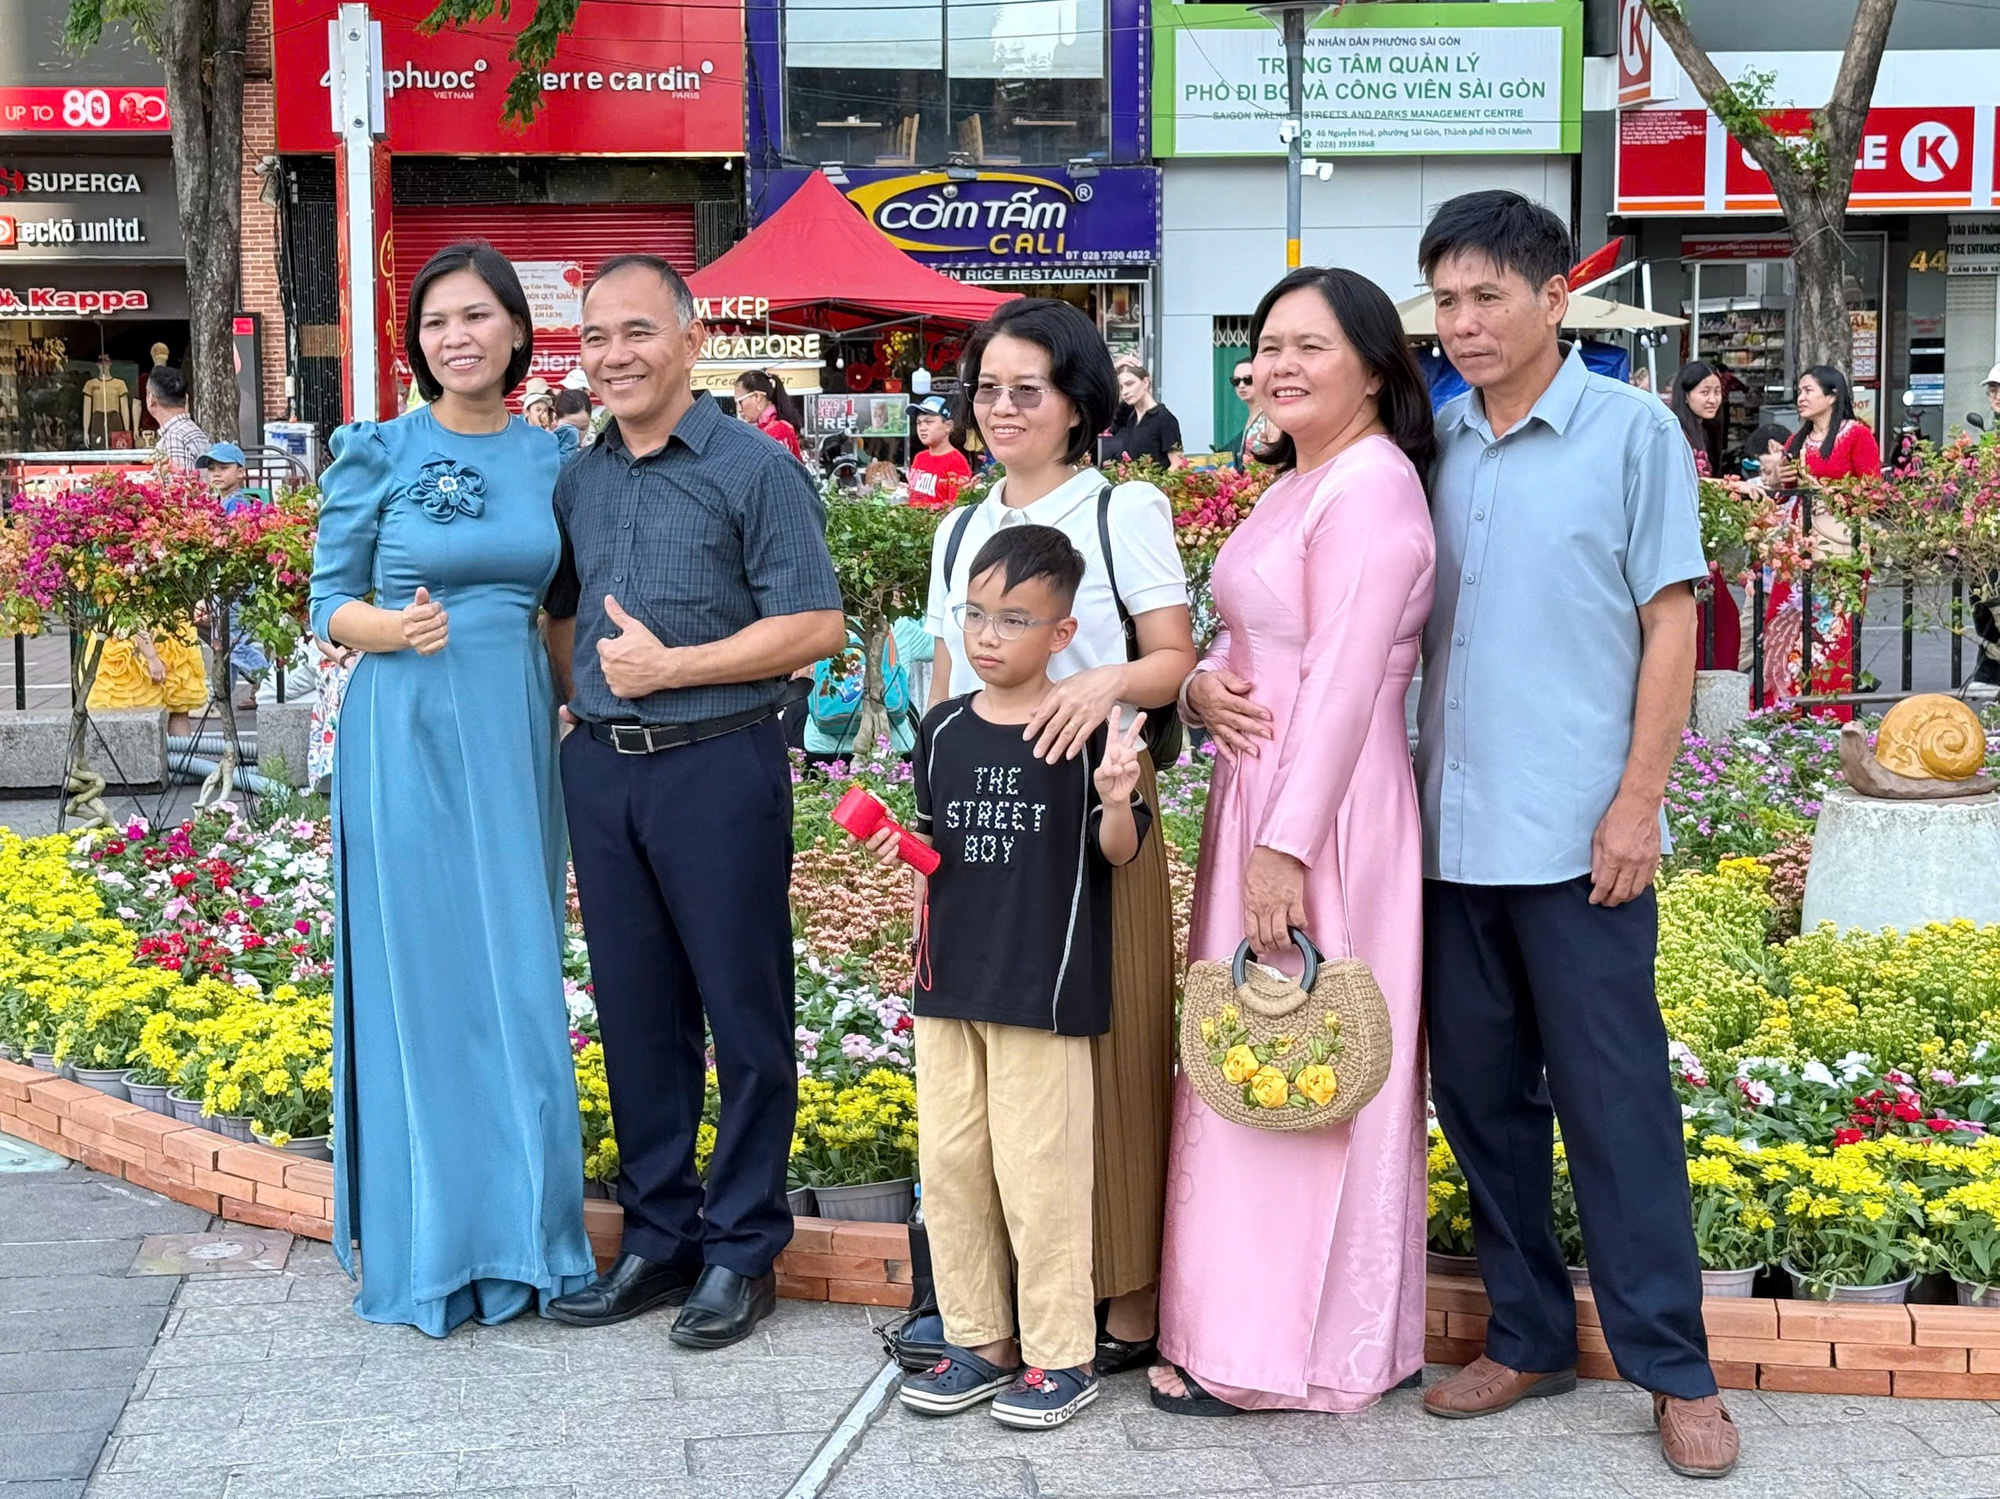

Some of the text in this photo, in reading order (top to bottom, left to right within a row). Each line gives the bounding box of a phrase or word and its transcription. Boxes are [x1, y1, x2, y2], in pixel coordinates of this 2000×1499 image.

[1303, 38, 1315, 47] AN
[1317, 36, 1346, 47] NHÂN
[1349, 35, 1370, 47] DÂN
[1438, 34, 1461, 46] GÒN
[1257, 51, 1481, 75] TRNG TÂM QUẢN LÝ
[388, 60, 476, 98] phuoc
[537, 65, 701, 92] erre cardin
[1237, 83, 1257, 101] ĐI
[1301, 79, 1329, 101] VÀ
[1335, 79, 1398, 101] CÔNG
[1403, 78, 1452, 100] VIÊN
[1459, 77, 1493, 99] SÀI
[1499, 77, 1546, 99] GÒN
[5, 105, 27, 121] UP
[31, 105, 54, 121] TO
[1212, 111, 1252, 120] SAIGON
[1351, 110, 1372, 119] AND
[1374, 110, 1408, 119] PARKS
[1410, 109, 1481, 118] MANAGEMENT
[1483, 109, 1524, 118] CENTRE
[1512, 127, 1533, 136] Minh
[27, 172, 142, 193] SUPERGA
[80, 216, 147, 243] unltd.
[988, 232, 1066, 255] CALI
[1082, 251, 1100, 260] 028
[1101, 251, 1125, 260] 7300
[1126, 250, 1151, 260] 4822
[965, 269, 1004, 280] RICE
[1009, 268, 1118, 280] RESTAURANT
[28, 288, 148, 315] Kappa
[720, 296, 769, 326] KẸP
[700, 333, 820, 359] NGAPORE
[706, 375, 736, 386] Crea
[974, 766, 1022, 795] THE
[946, 800, 1046, 832] STREET
[964, 835, 1015, 864] BOY
[1043, 1399, 1078, 1423] crocs
